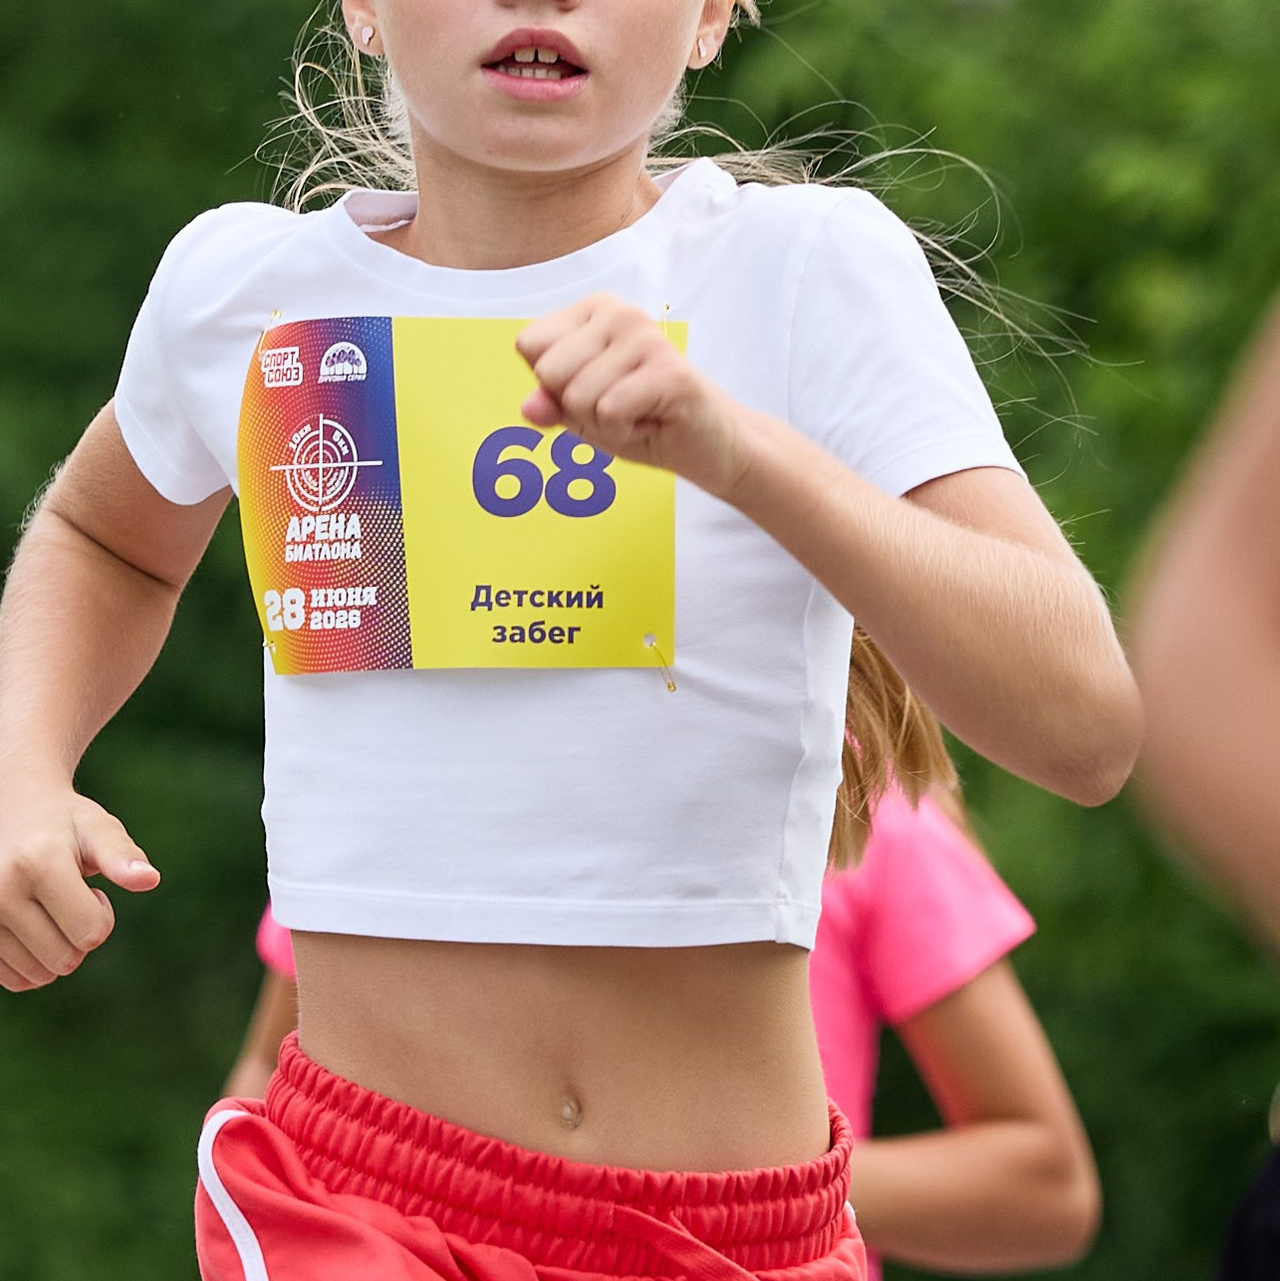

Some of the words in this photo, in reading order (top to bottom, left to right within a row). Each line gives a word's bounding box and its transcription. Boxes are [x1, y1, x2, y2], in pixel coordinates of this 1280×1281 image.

[264, 351, 296, 368] СПОРТ
[268, 367, 300, 383] СОЮЗ
[472, 426, 617, 518] 68
[285, 513, 361, 542] АРЕНА
[285, 541, 362, 563] БИАТЛОНА
[263, 588, 305, 632] 28
[310, 586, 378, 608] ИЮНЯ
[470, 584, 604, 611] Детский
[310, 609, 361, 630] 2026
[492, 620, 581, 644] забег
